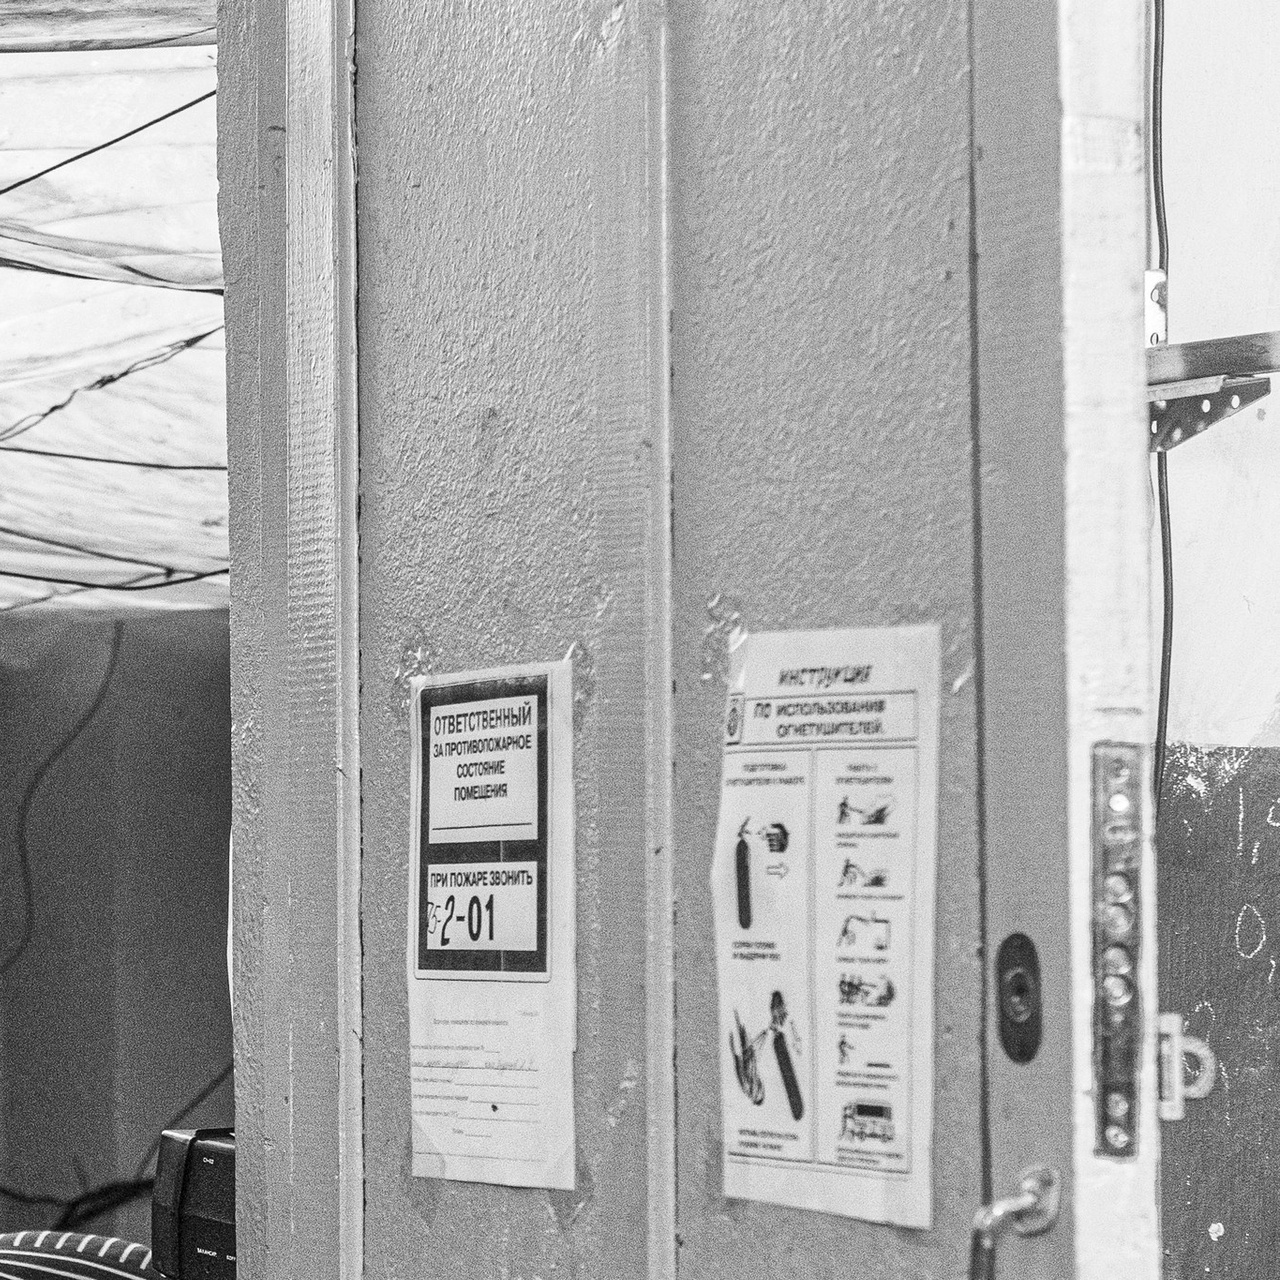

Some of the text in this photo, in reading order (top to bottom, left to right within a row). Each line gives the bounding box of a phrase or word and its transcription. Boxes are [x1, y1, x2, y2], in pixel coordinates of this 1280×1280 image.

[433, 701, 532, 736] ОТВЕТСТВЕННЫЙ
[433, 734, 532, 758] ЗА ПРОТИВОПОЖАРНОЕ
[456, 760, 506, 778] СОСТОЯНИЕ
[454, 783, 508, 801] ПОМЕЩЕНИЯ
[430, 870, 534, 887] ПРИ ПОЖАРЕ ЗВОНИТЬ
